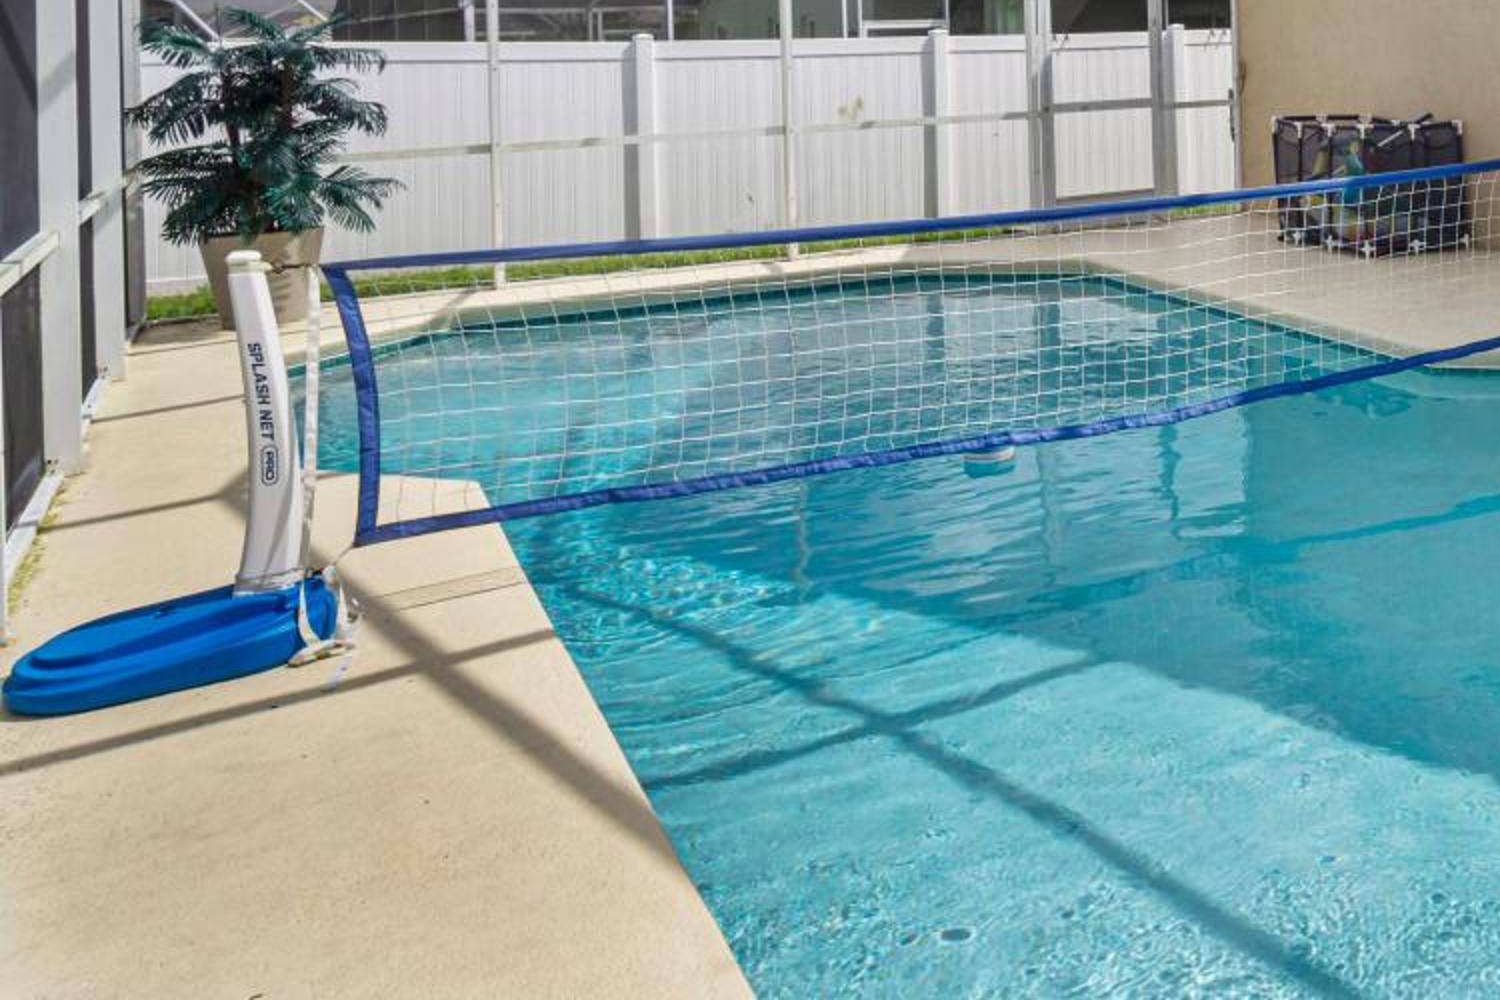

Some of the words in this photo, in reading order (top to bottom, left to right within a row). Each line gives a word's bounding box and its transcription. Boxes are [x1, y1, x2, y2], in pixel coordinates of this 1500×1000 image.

[247, 343, 271, 405] SPLASH
[259, 409, 275, 441] NET
[265, 450, 275, 481] PRO
